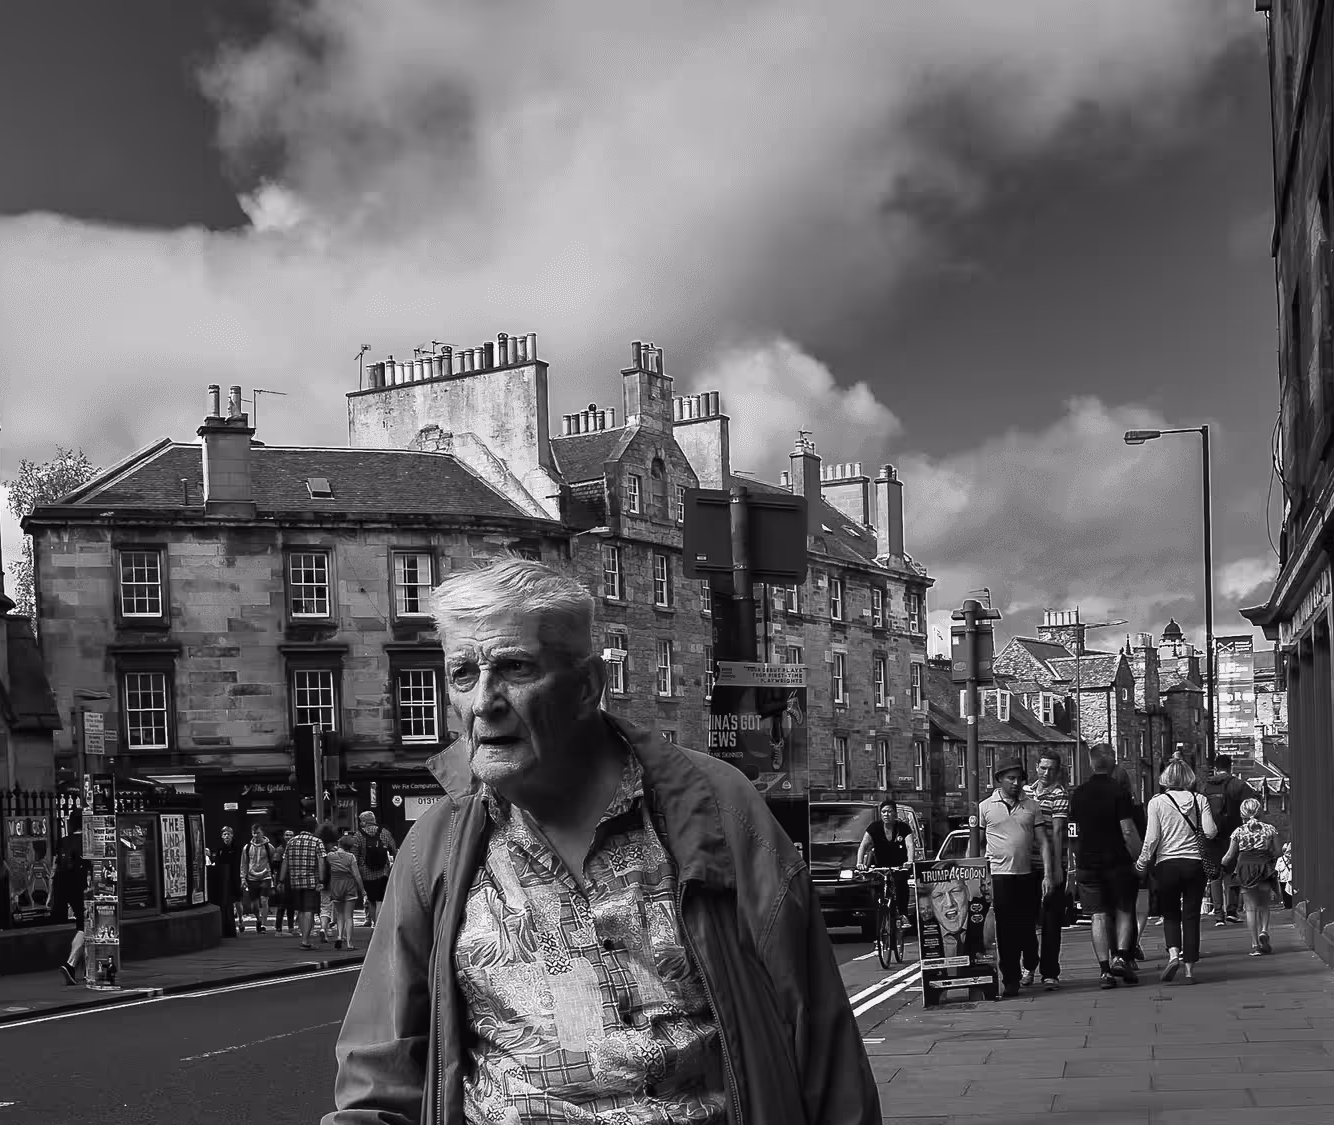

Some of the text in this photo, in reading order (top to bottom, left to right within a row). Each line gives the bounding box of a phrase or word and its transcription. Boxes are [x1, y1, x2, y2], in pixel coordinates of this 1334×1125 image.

[740, 714, 762, 731] GOT
[266, 783, 292, 794] Golden
[162, 817, 179, 832] THE
[163, 833, 179, 848] UND
[921, 865, 986, 883] TRUMPAGEDDON
